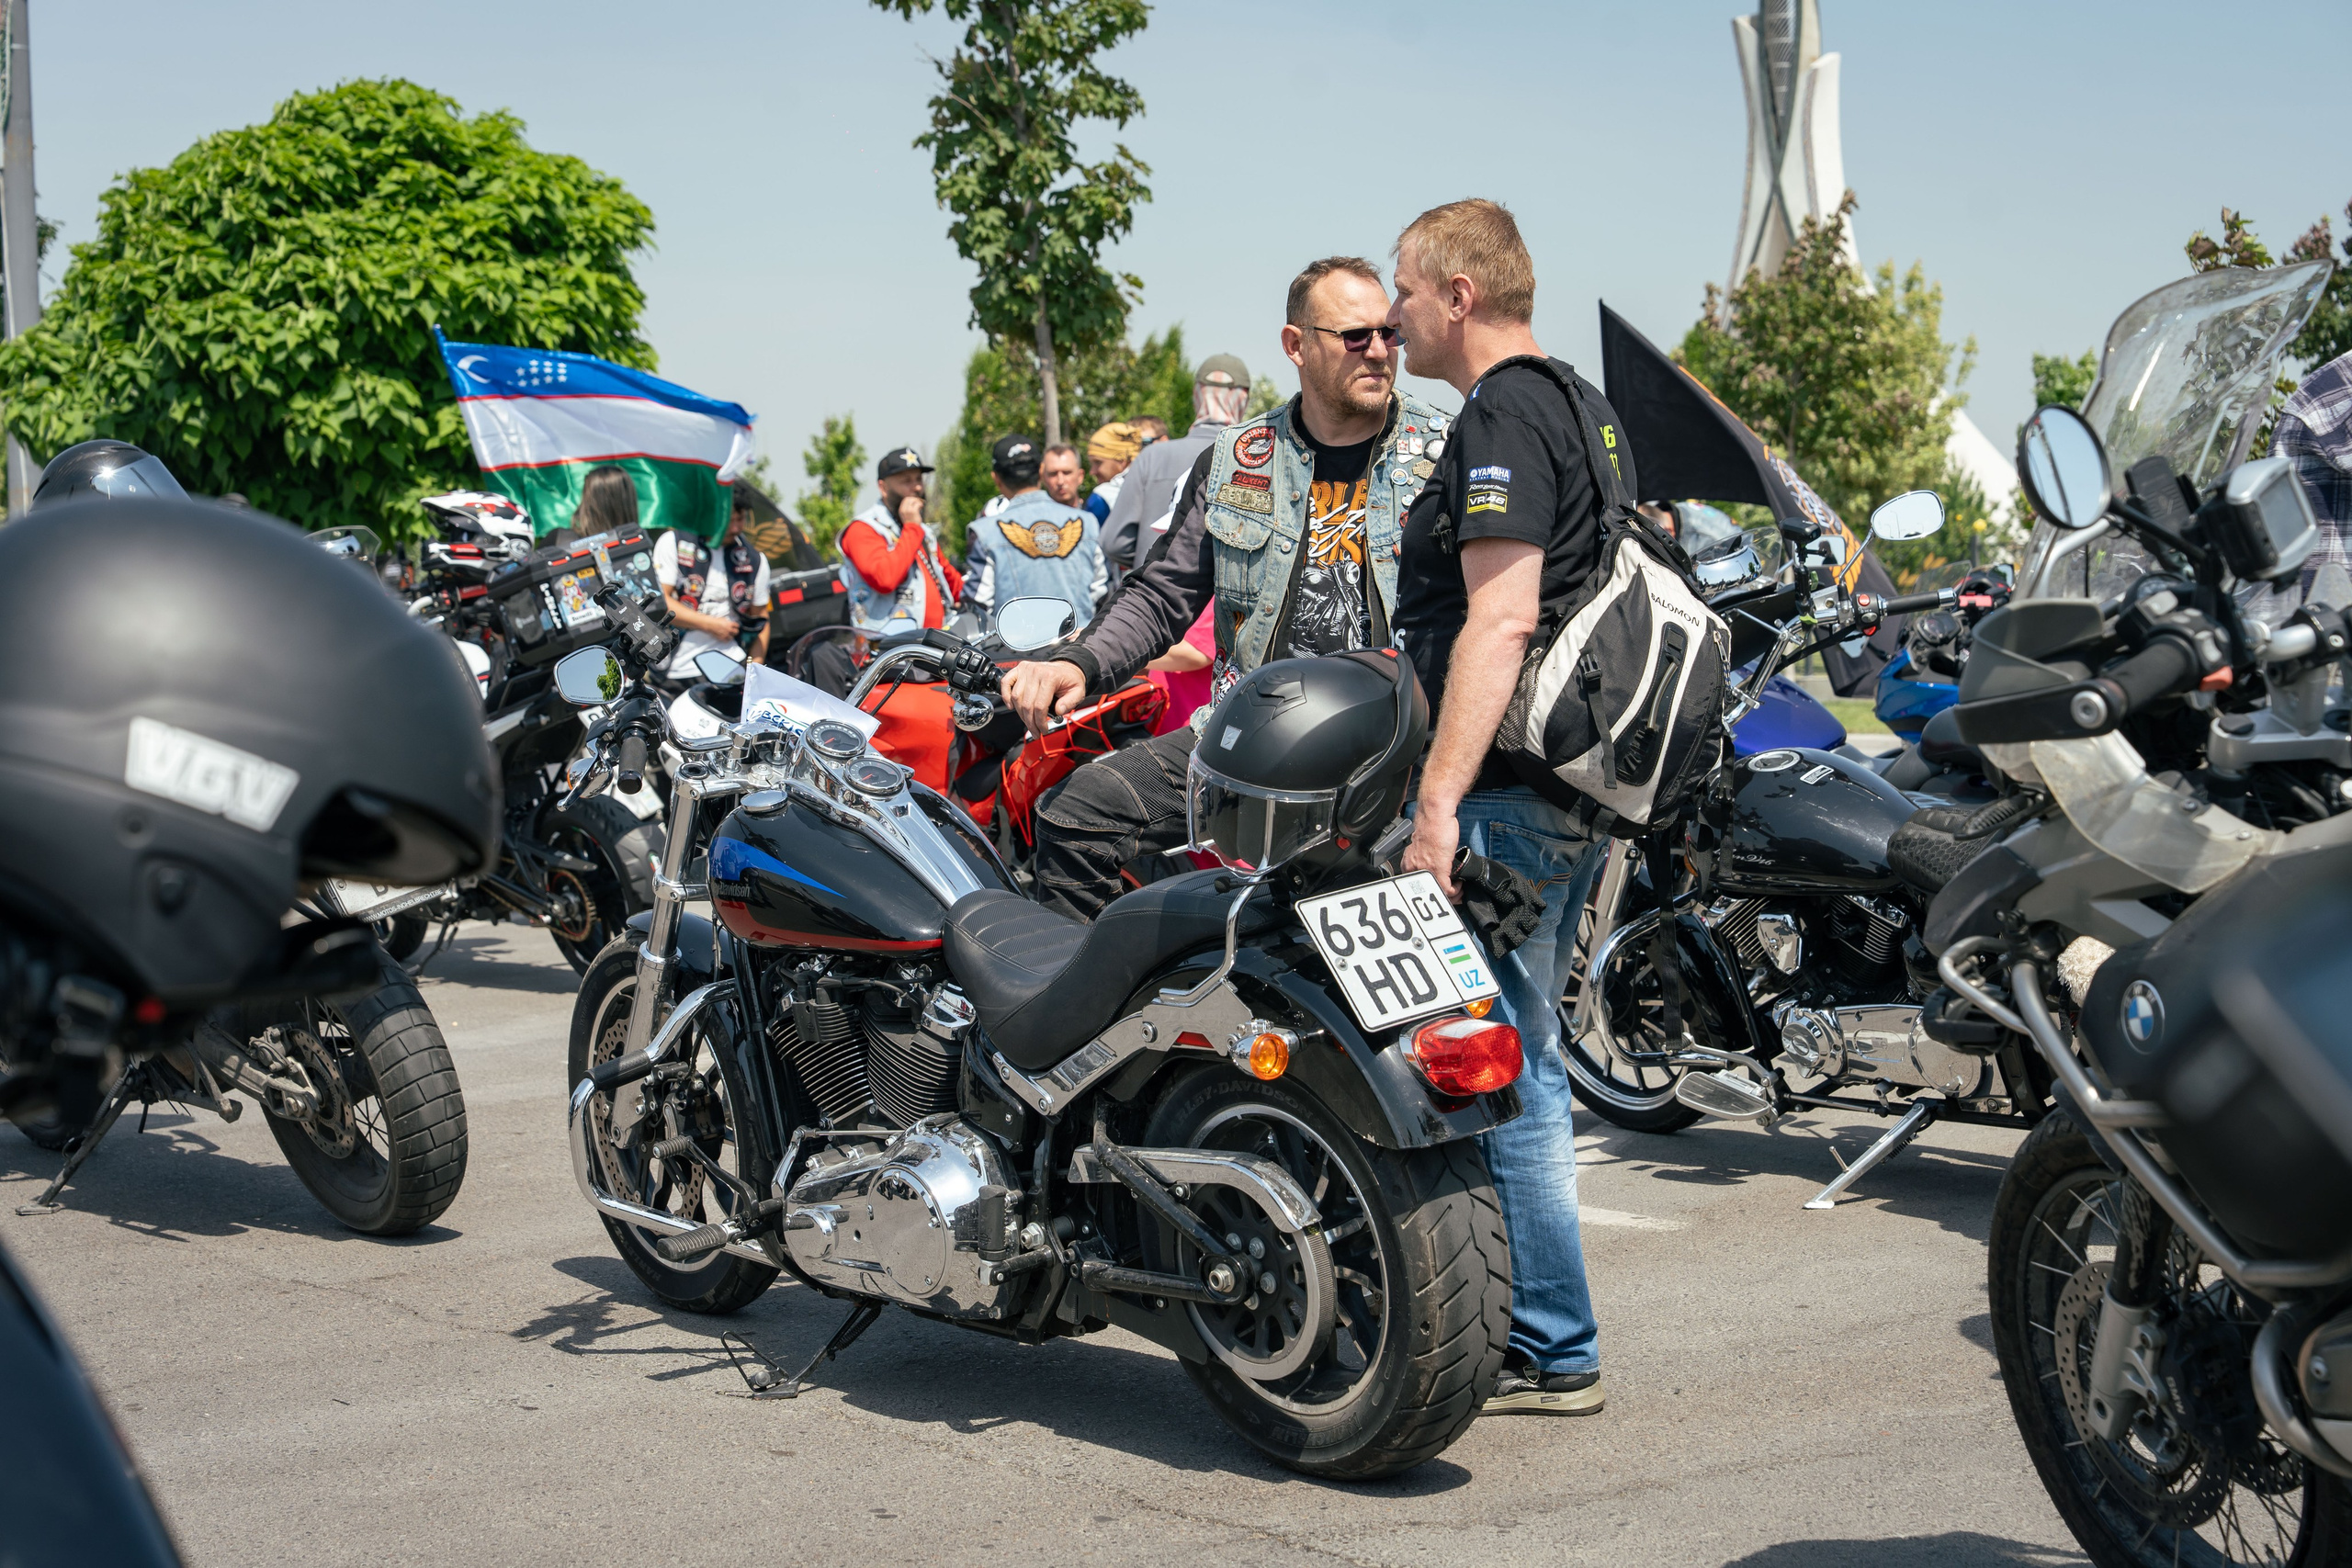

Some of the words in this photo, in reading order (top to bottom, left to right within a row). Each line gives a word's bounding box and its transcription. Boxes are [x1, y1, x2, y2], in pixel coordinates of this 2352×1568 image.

[1477, 467, 1510, 479] YAMAHA
[1651, 592, 1700, 626] SALOMON
[1319, 891, 1413, 957] 636
[1411, 892, 1450, 922] 01
[1353, 952, 1439, 1016] HD
[1458, 969, 1486, 989] UZ
[2165, 1376, 2186, 1415] BMW
